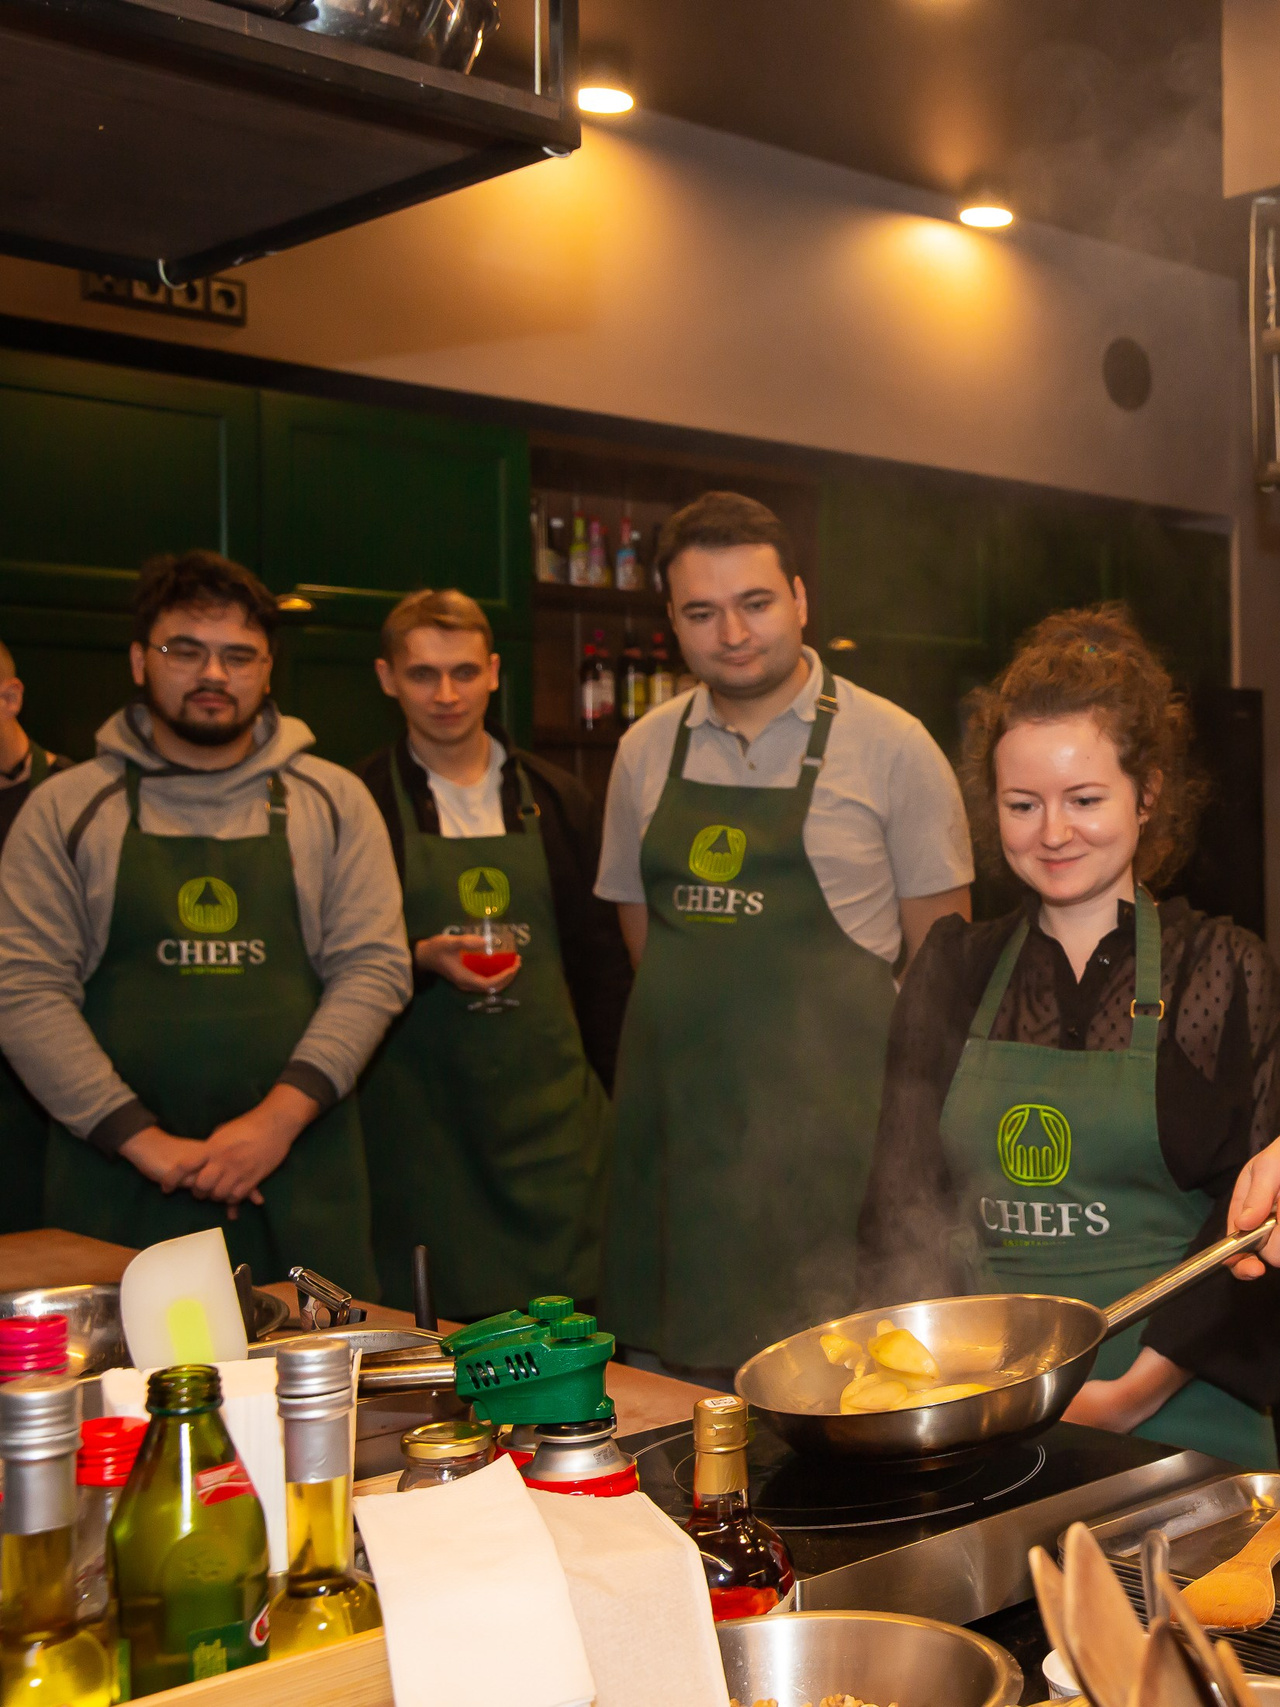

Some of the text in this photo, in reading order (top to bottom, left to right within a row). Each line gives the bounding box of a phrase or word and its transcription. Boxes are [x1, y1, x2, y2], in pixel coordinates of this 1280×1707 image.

[672, 884, 765, 915] CHEFS
[156, 938, 266, 966] CHEFS
[979, 1197, 1111, 1237] CHEFS
